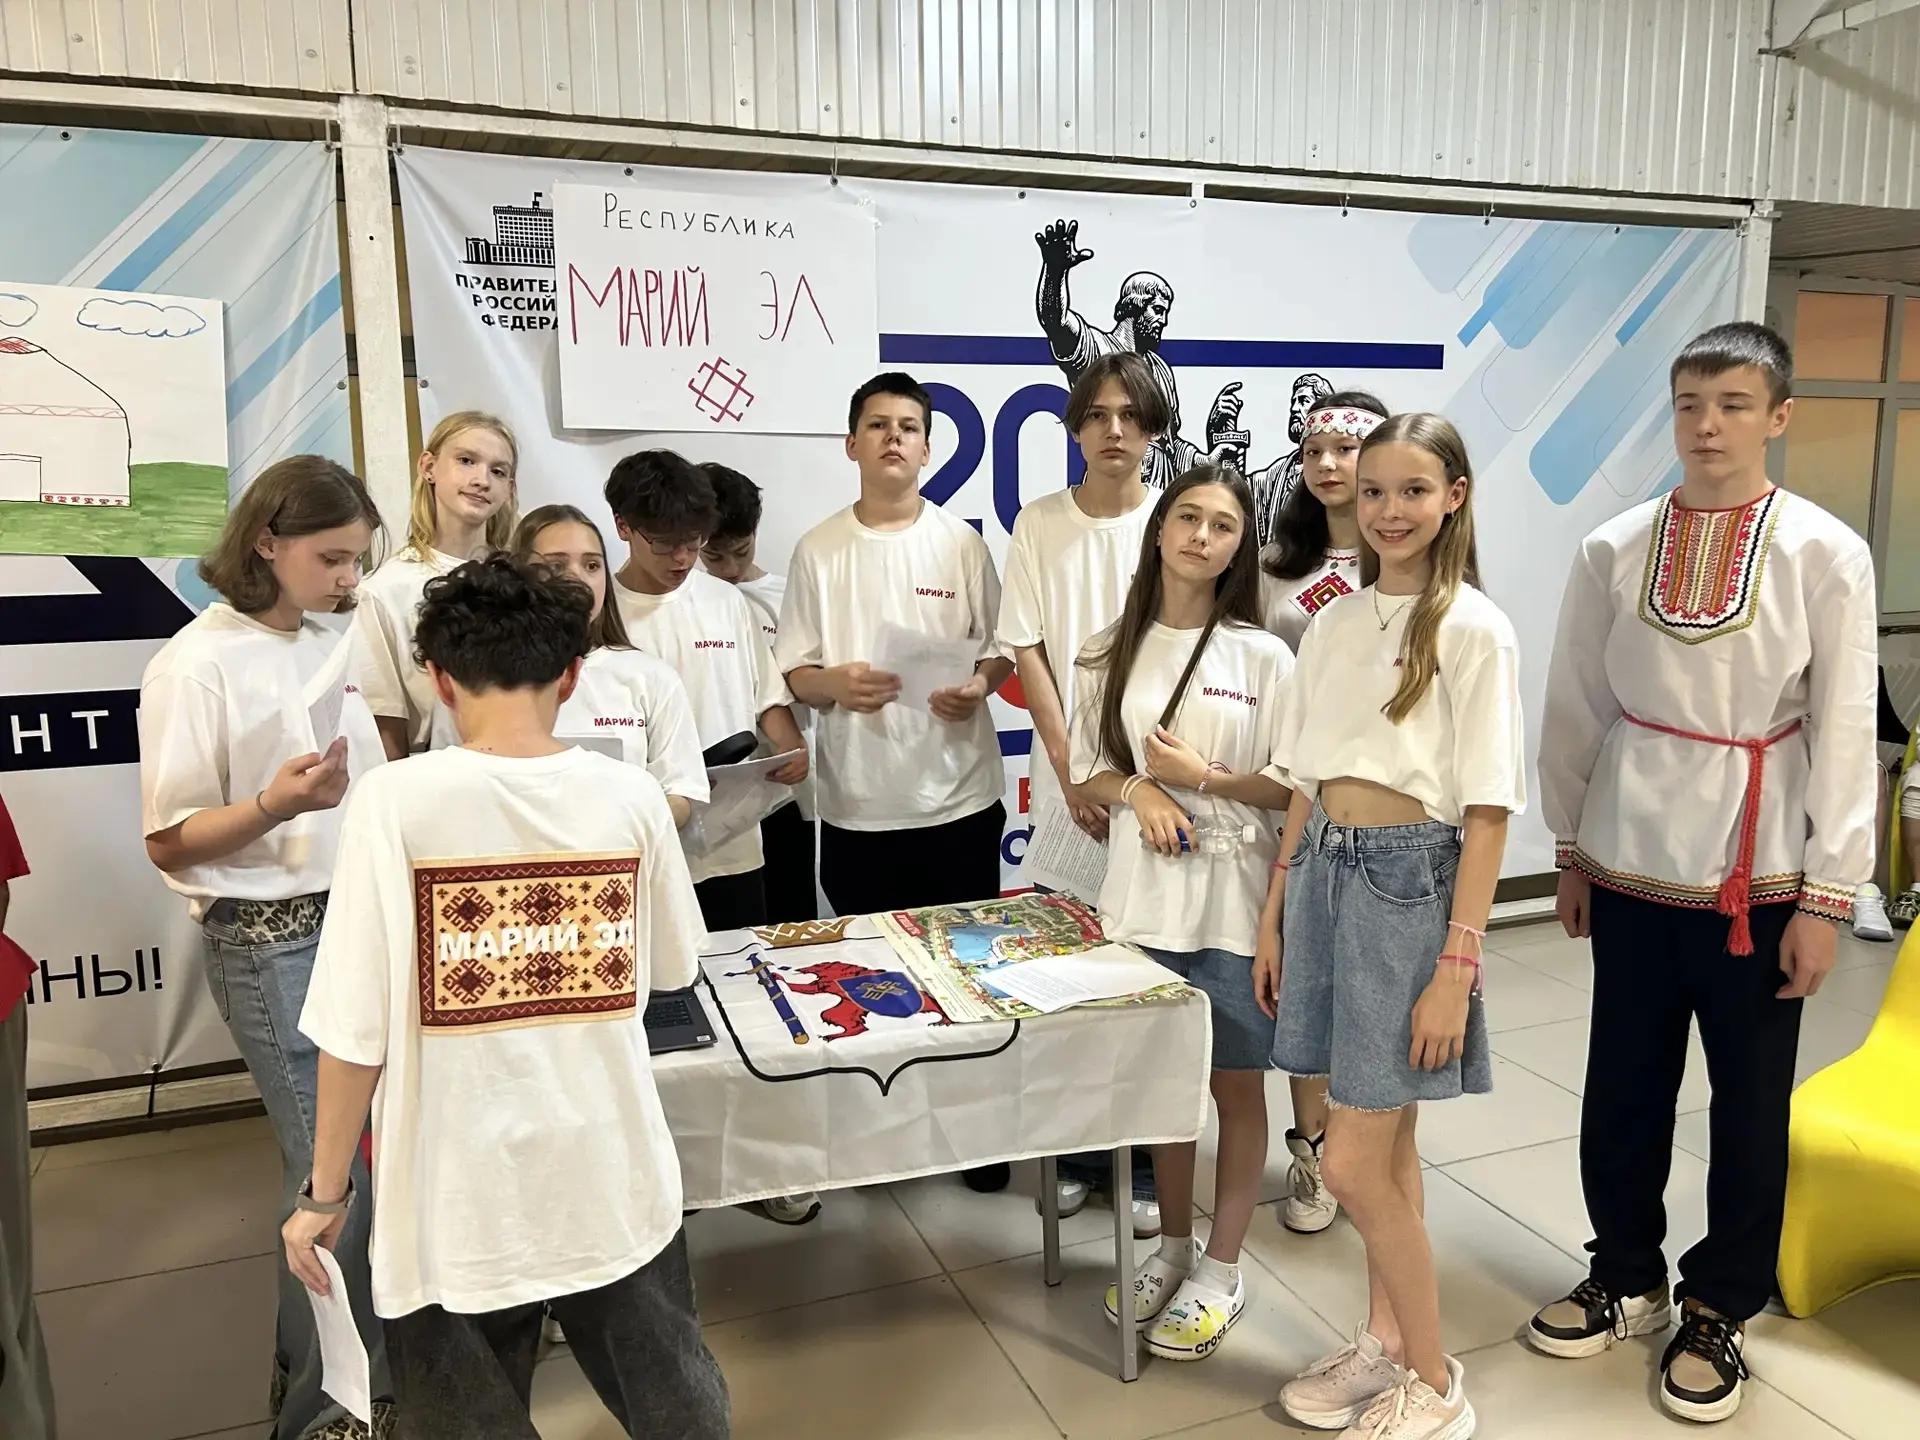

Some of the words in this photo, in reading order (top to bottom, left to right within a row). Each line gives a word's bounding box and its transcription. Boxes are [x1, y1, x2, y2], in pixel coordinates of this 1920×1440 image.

[603, 193, 795, 239] РЕСПУБЛИКА
[569, 263, 710, 347] МАРИЙ
[758, 271, 834, 345] ЭЛ
[1203, 687, 1243, 702] МАРИЙ
[1244, 695, 1257, 707] ЭЛ
[594, 717, 634, 727] МАРИЙ
[439, 917, 580, 962] МАРИЙ
[592, 919, 633, 950] ЭЛ
[1195, 1323, 1227, 1354] crocs
